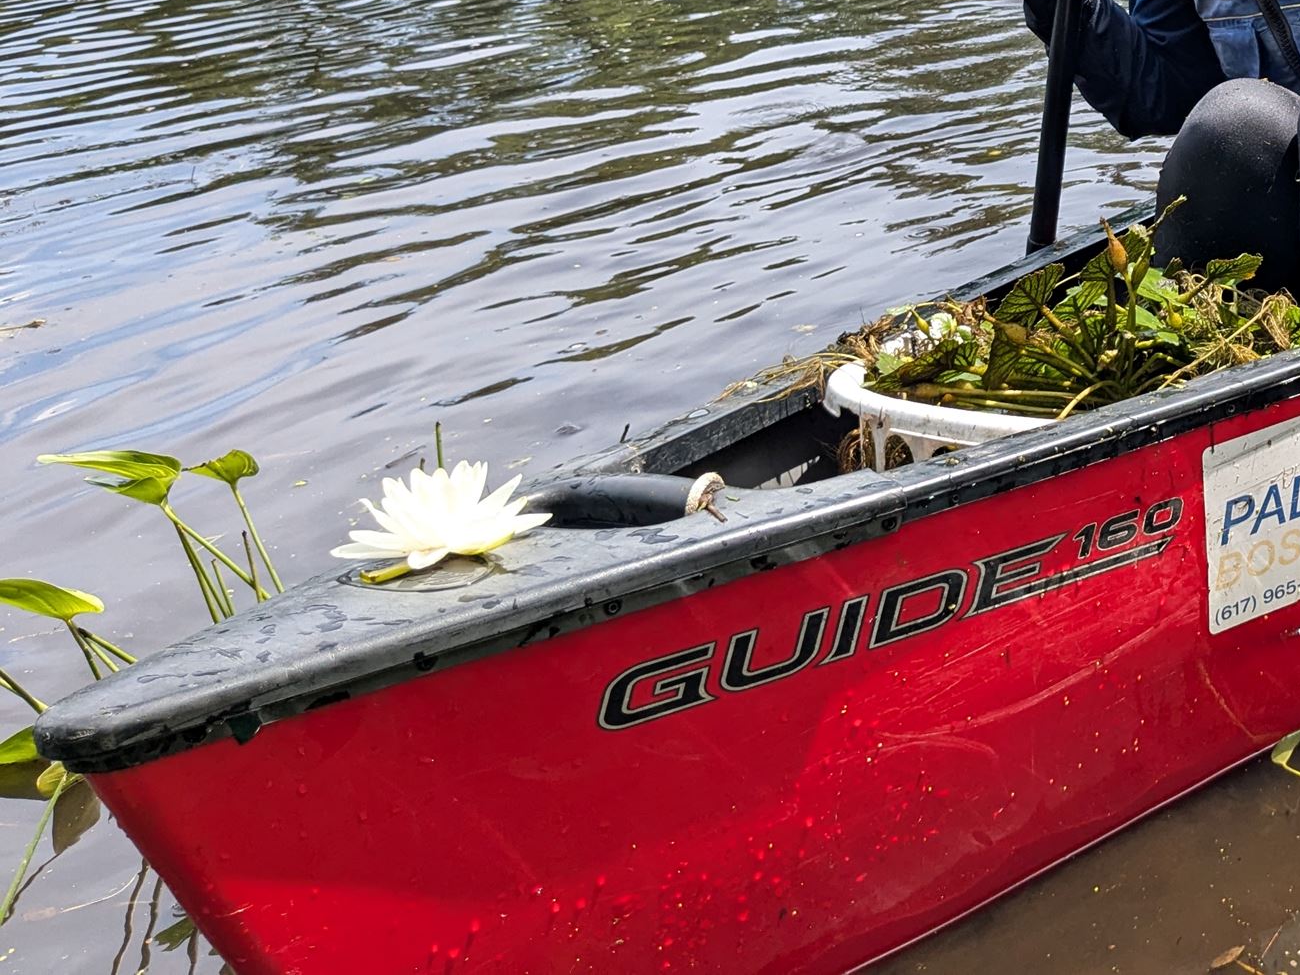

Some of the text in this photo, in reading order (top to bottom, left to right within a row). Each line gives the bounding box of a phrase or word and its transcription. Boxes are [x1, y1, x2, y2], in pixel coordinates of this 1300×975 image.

[596, 496, 1184, 730] GUIDE 160
[1215, 594, 1257, 626] (617)
